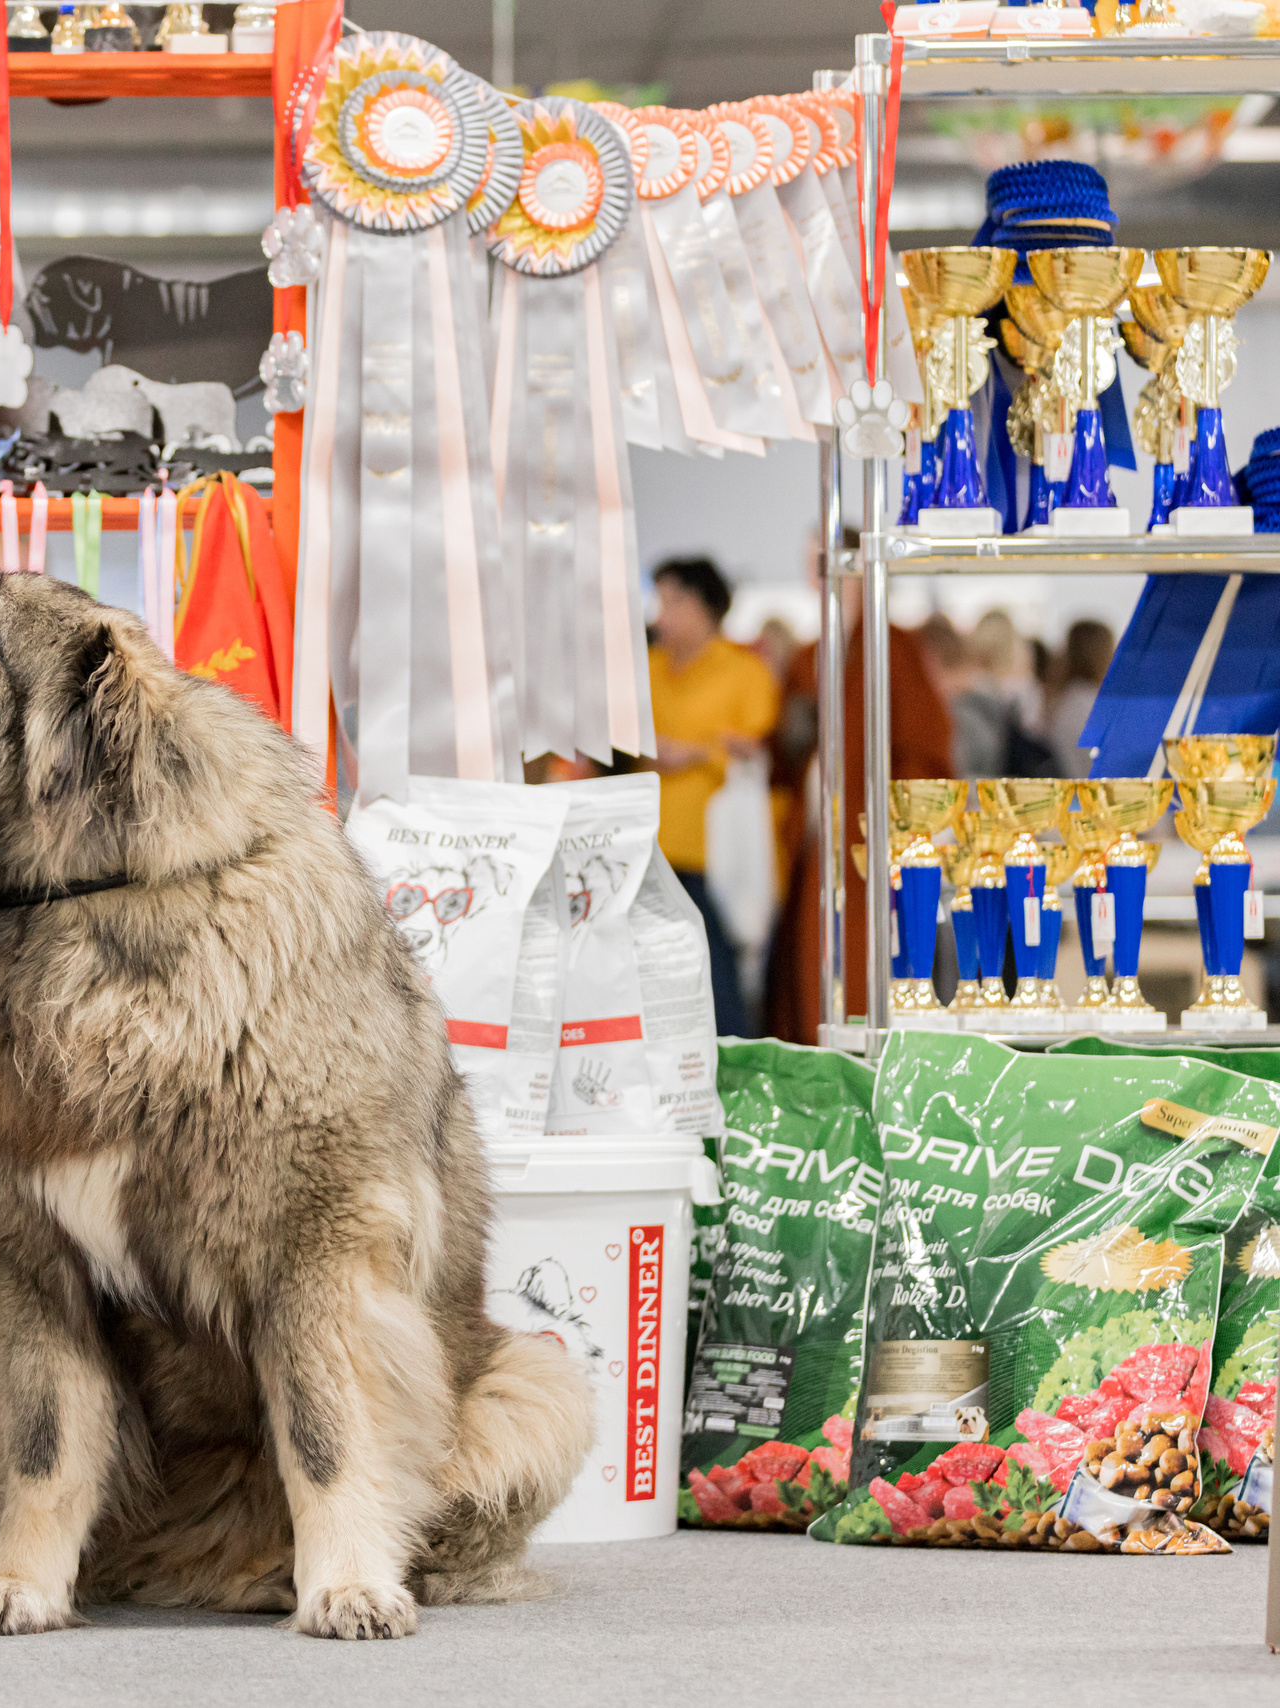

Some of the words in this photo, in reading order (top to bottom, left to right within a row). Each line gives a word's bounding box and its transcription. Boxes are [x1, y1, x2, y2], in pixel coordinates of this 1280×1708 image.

[387, 828, 434, 846] BEST
[1156, 1105, 1194, 1130] Super
[1197, 1120, 1259, 1141] mium
[721, 1128, 884, 1207] DRIVE
[881, 1123, 1061, 1178] DRIVE
[1073, 1144, 1214, 1205] DOG
[760, 1196, 812, 1218] для
[814, 1200, 876, 1234] соба
[922, 1184, 978, 1209] для
[983, 1187, 1055, 1217] собак
[729, 1205, 775, 1236] food
[730, 1242, 785, 1265] appetit
[898, 1237, 949, 1259] aetit
[770, 1291, 795, 1316] D.
[944, 1285, 968, 1309] D.
[637, 1237, 661, 1391] DINNER
[746, 1350, 776, 1365] FOOD
[633, 1399, 656, 1495] BEST
